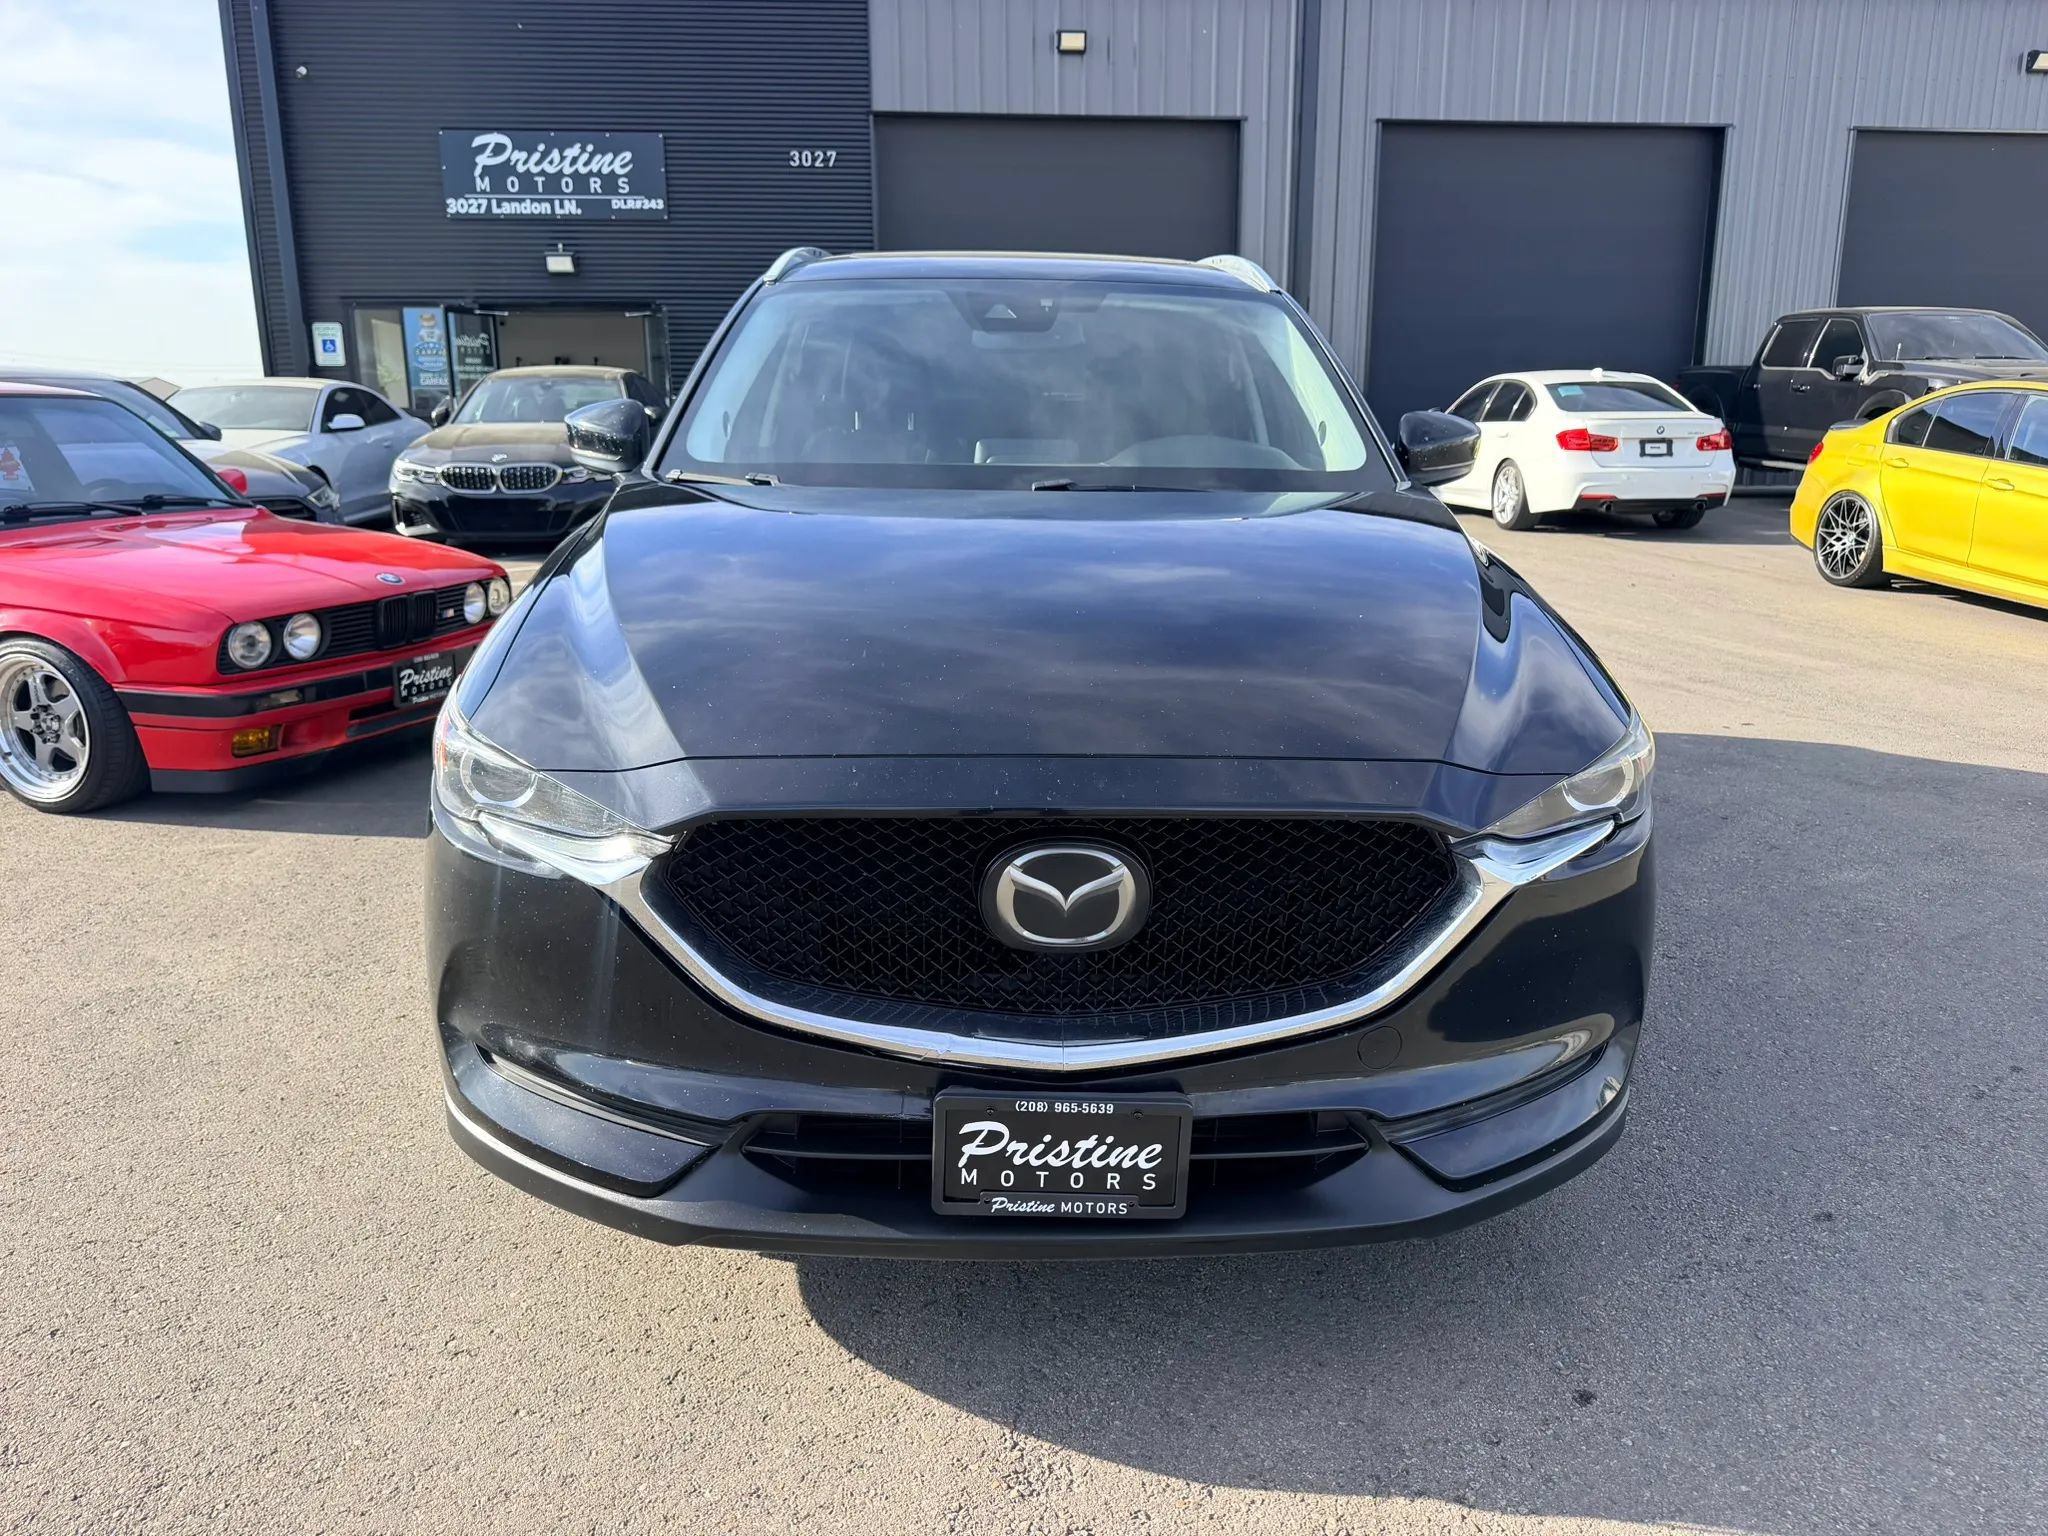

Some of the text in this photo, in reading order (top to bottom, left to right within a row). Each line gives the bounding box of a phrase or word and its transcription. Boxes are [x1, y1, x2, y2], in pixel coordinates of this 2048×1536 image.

[471, 132, 633, 177] Pristine
[789, 150, 837, 167] 3027
[475, 176, 630, 193] MOTORS
[446, 197, 582, 215] 3027 Landon LN.
[400, 666, 452, 691] Pristine
[401, 678, 452, 697] MOTORS
[1015, 1101, 1114, 1114] (208) 965-5639
[958, 1120, 1163, 1169] Pristine
[961, 1168, 1157, 1190] MOTORS
[991, 1197, 1128, 1214] Pristine MOTORS
